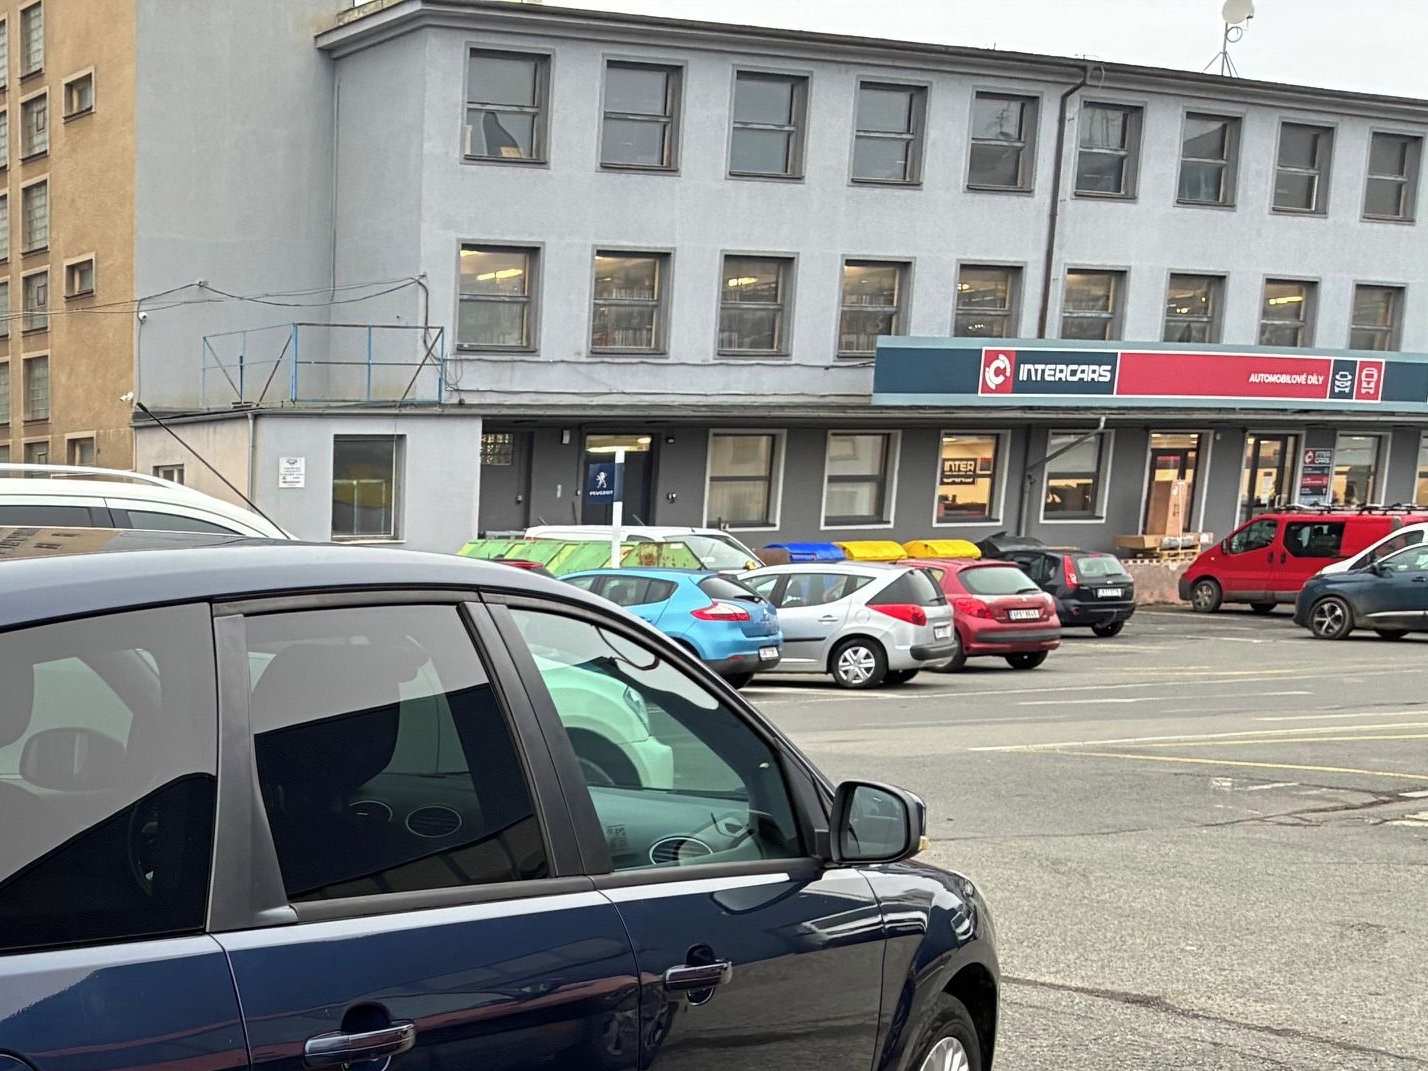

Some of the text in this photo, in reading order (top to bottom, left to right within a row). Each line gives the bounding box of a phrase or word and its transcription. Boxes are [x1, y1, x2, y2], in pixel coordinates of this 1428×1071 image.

[1019, 363, 1112, 382] INTERCARS
[1249, 373, 1324, 385] AUTOMOBILOVÉ DÍLY
[944, 461, 975, 471] INTER
